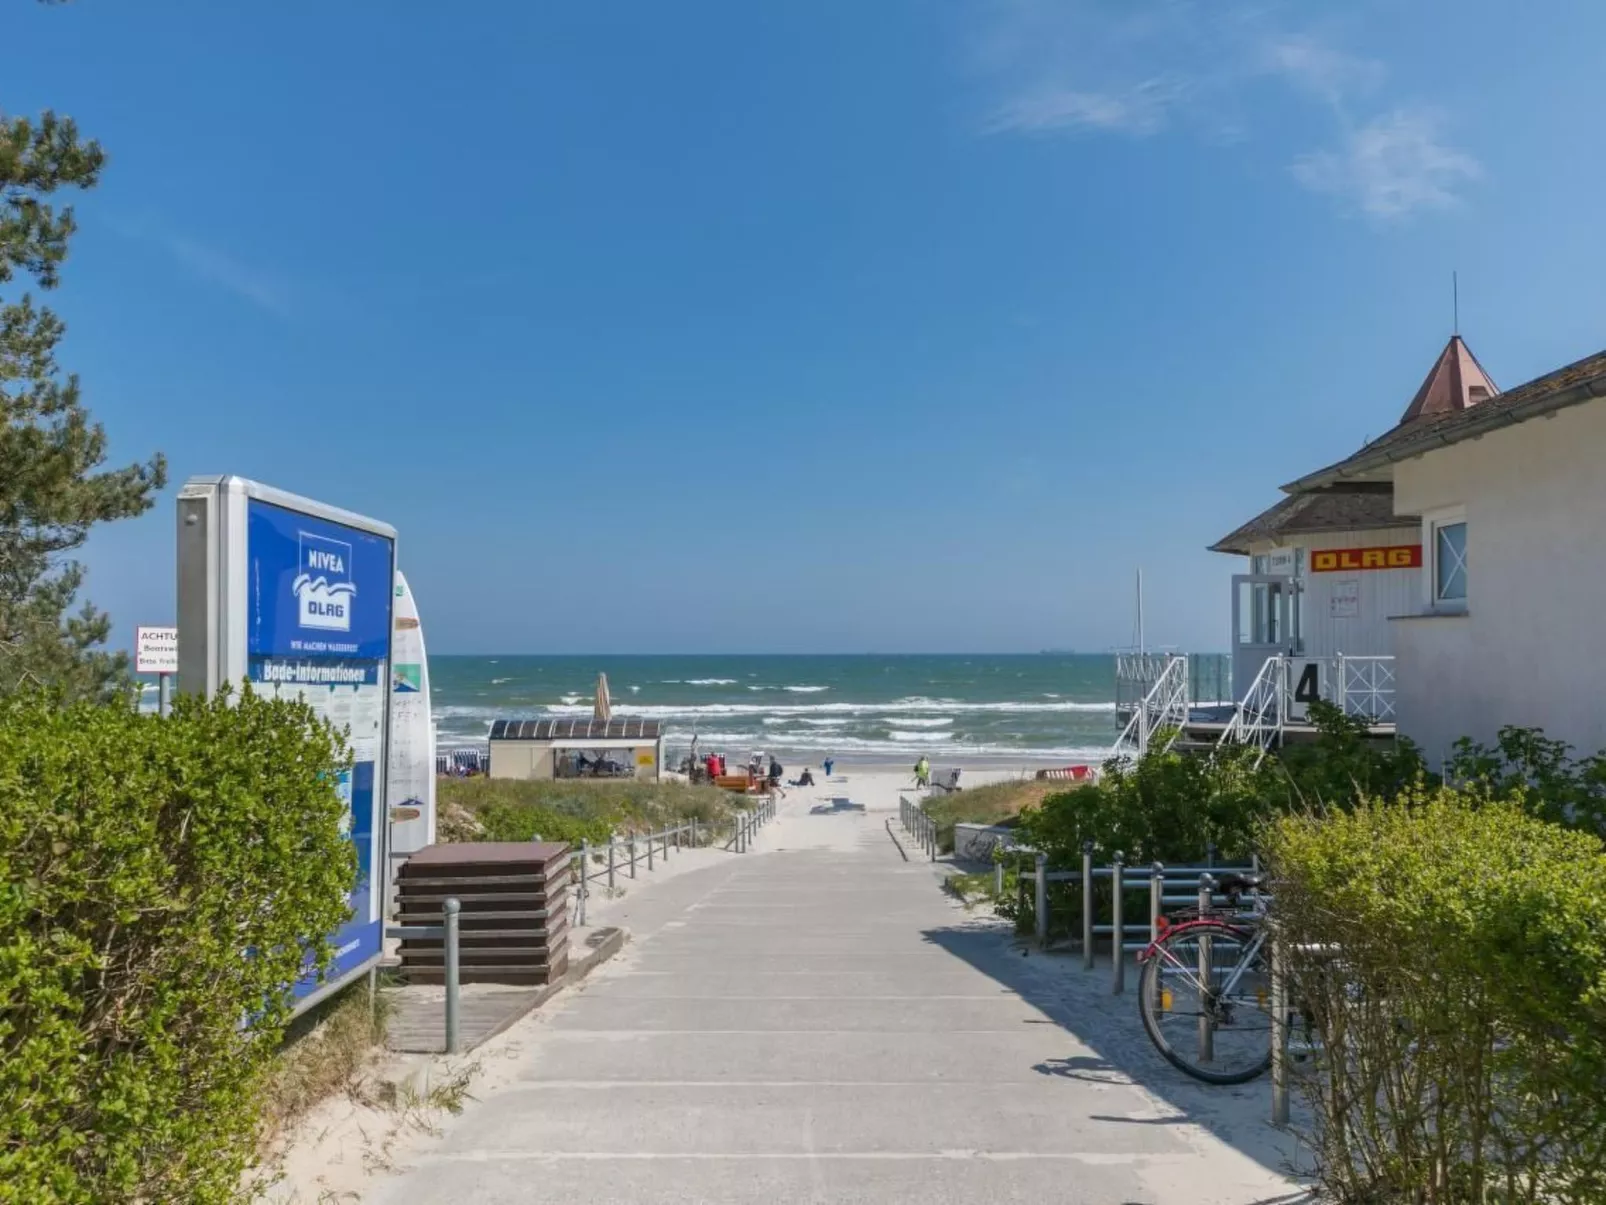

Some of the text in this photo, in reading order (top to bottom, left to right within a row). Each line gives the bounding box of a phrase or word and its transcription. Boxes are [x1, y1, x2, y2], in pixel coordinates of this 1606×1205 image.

[308, 549, 345, 574] NIVEA
[1316, 549, 1411, 569] DLRG
[308, 601, 345, 618] DLRG
[264, 659, 365, 682] Bade-Informationen
[1295, 663, 1320, 703] 4
